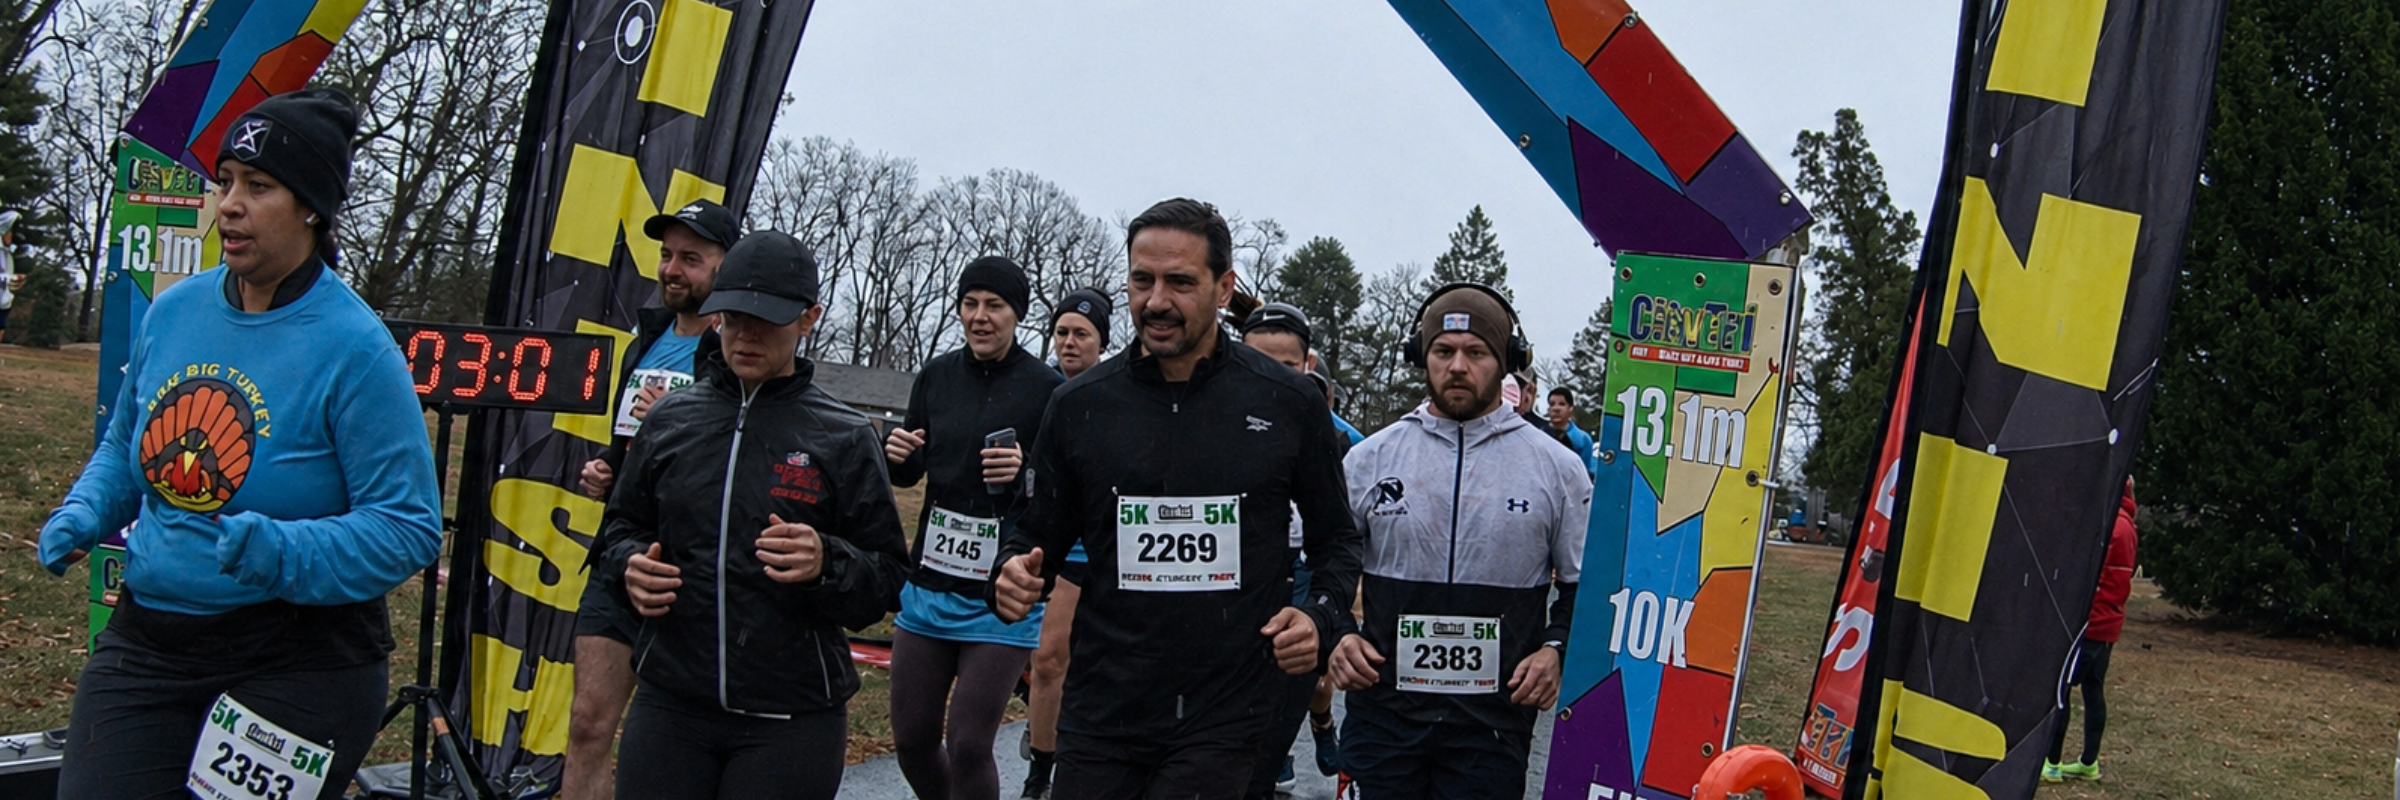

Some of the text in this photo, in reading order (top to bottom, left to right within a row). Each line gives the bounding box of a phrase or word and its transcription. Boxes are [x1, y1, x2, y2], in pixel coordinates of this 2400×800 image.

[118, 223, 204, 276] 13.1m
[407, 330, 601, 401] 03:01
[186, 363, 220, 378] BIG
[227, 366, 271, 438] TURKEY
[1617, 385, 1746, 469] 13.1m
[977, 523, 998, 539] 5K
[1120, 503, 1149, 525] 5K
[1204, 503, 1237, 525] 5K
[934, 533, 982, 562] 2145
[1137, 532, 1217, 563] 2269
[1400, 620, 1425, 638] 5K
[1473, 622, 1497, 640] 5K
[1609, 587, 1696, 668] 10K
[1413, 643, 1483, 671] 2383
[211, 700, 329, 778] 5K 5K
[209, 741, 295, 800] 2353
